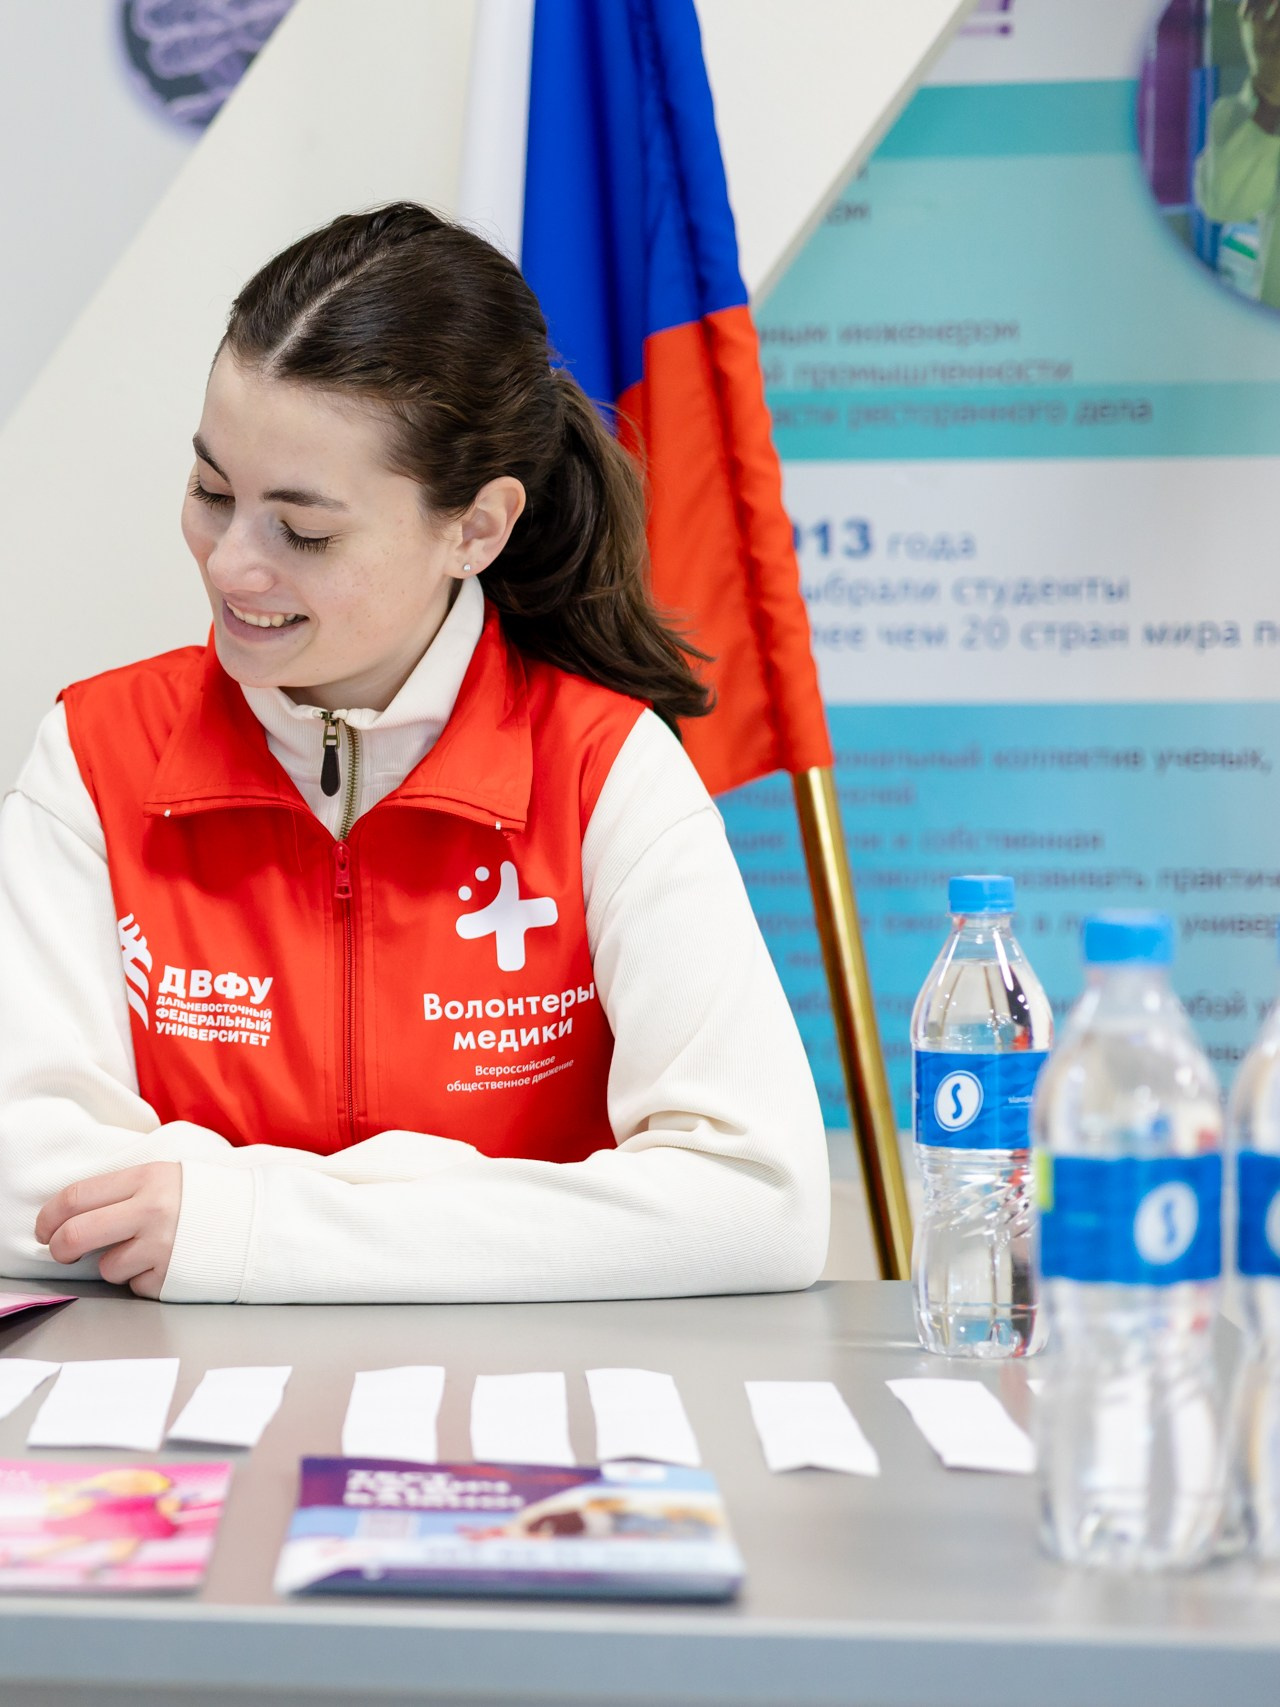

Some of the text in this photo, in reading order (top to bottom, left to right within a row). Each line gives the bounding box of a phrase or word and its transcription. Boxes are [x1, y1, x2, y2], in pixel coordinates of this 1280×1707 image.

[885, 530, 977, 562] года
[951, 572, 1132, 611] студенты
[959, 613, 1010, 652] 20
[1020, 618, 1131, 656] стран
[1142, 618, 1242, 655] мира
[158, 964, 274, 1005] ДВФУ
[423, 981, 596, 1021] Волонтеры
[155, 1007, 272, 1033] ФЕДЕРАЛЬНЫЙ
[156, 995, 272, 1020] ДАЛЬНЕВОСТОЧНЫЙ
[155, 1021, 270, 1047] УНИВЕРСИТЕТ
[453, 1017, 573, 1053] медики
[446, 1058, 574, 1092] общественное движение
[475, 1055, 556, 1077] Всероссийское
